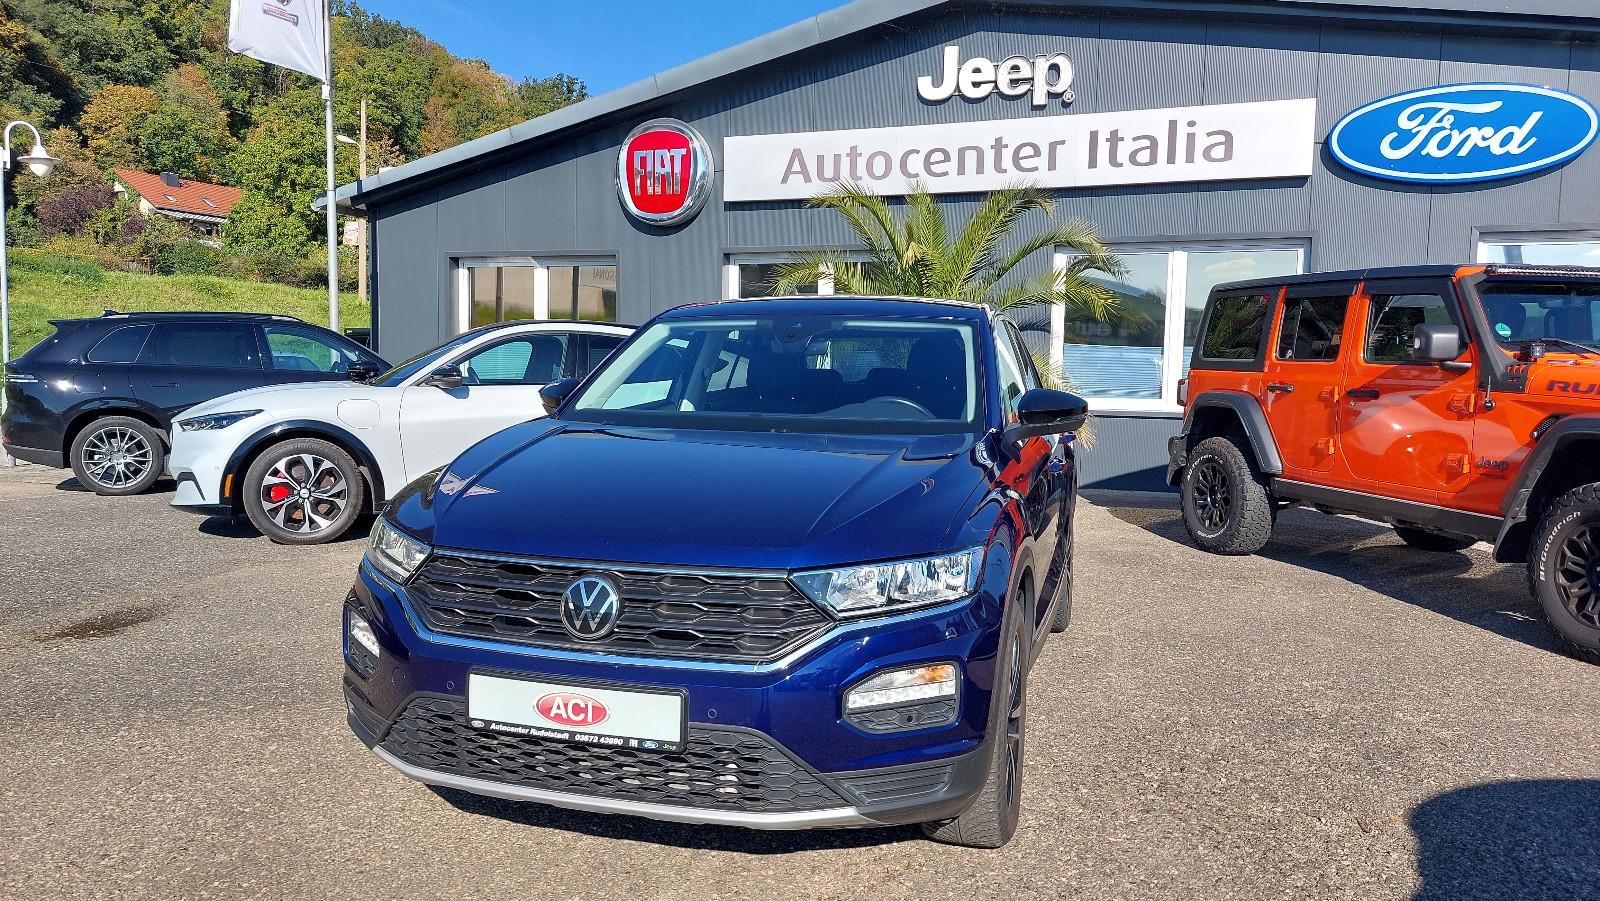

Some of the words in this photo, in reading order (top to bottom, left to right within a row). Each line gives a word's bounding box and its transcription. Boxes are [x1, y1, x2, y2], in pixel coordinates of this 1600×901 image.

[917, 45, 1074, 105] Jeep
[780, 135, 1067, 185] Autocenter
[1087, 119, 1234, 169] Italia
[1379, 100, 1544, 160] Ford
[633, 147, 687, 196] FIAT
[1538, 510, 1582, 582] BFGoodrich
[490, 722, 529, 734] Autocenter
[530, 728, 569, 740] Rudolstadt
[549, 695, 593, 723] ACI
